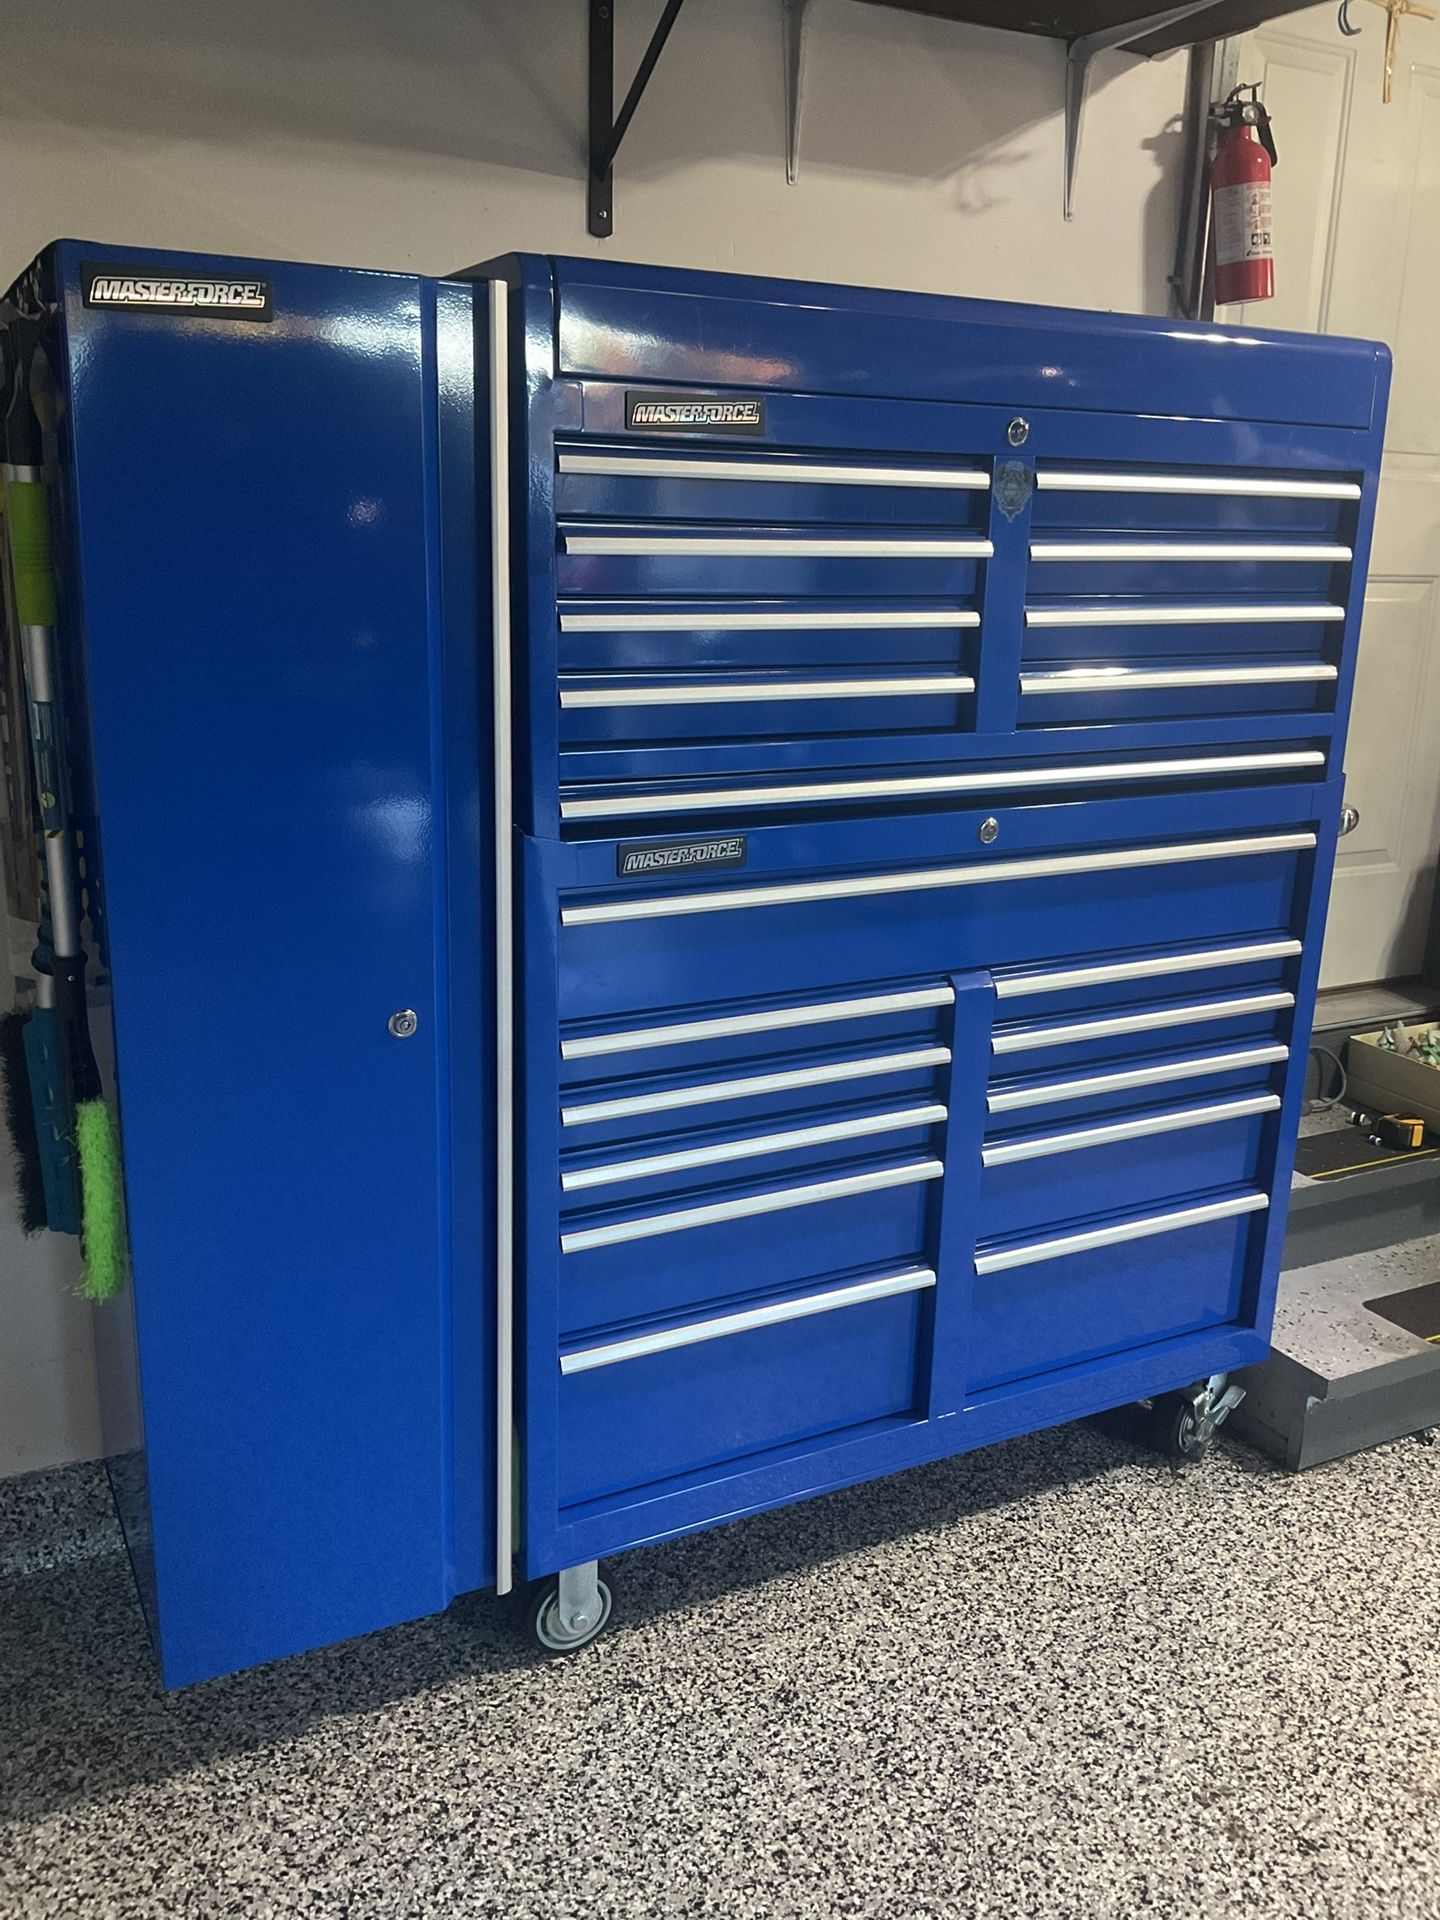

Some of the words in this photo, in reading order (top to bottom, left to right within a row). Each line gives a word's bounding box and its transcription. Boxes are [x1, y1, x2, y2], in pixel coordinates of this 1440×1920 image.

[95, 280, 260, 304] MASTERFORCE
[636, 405, 757, 422] MASTERFORCE
[627, 842, 738, 870] MASTERFORCE
